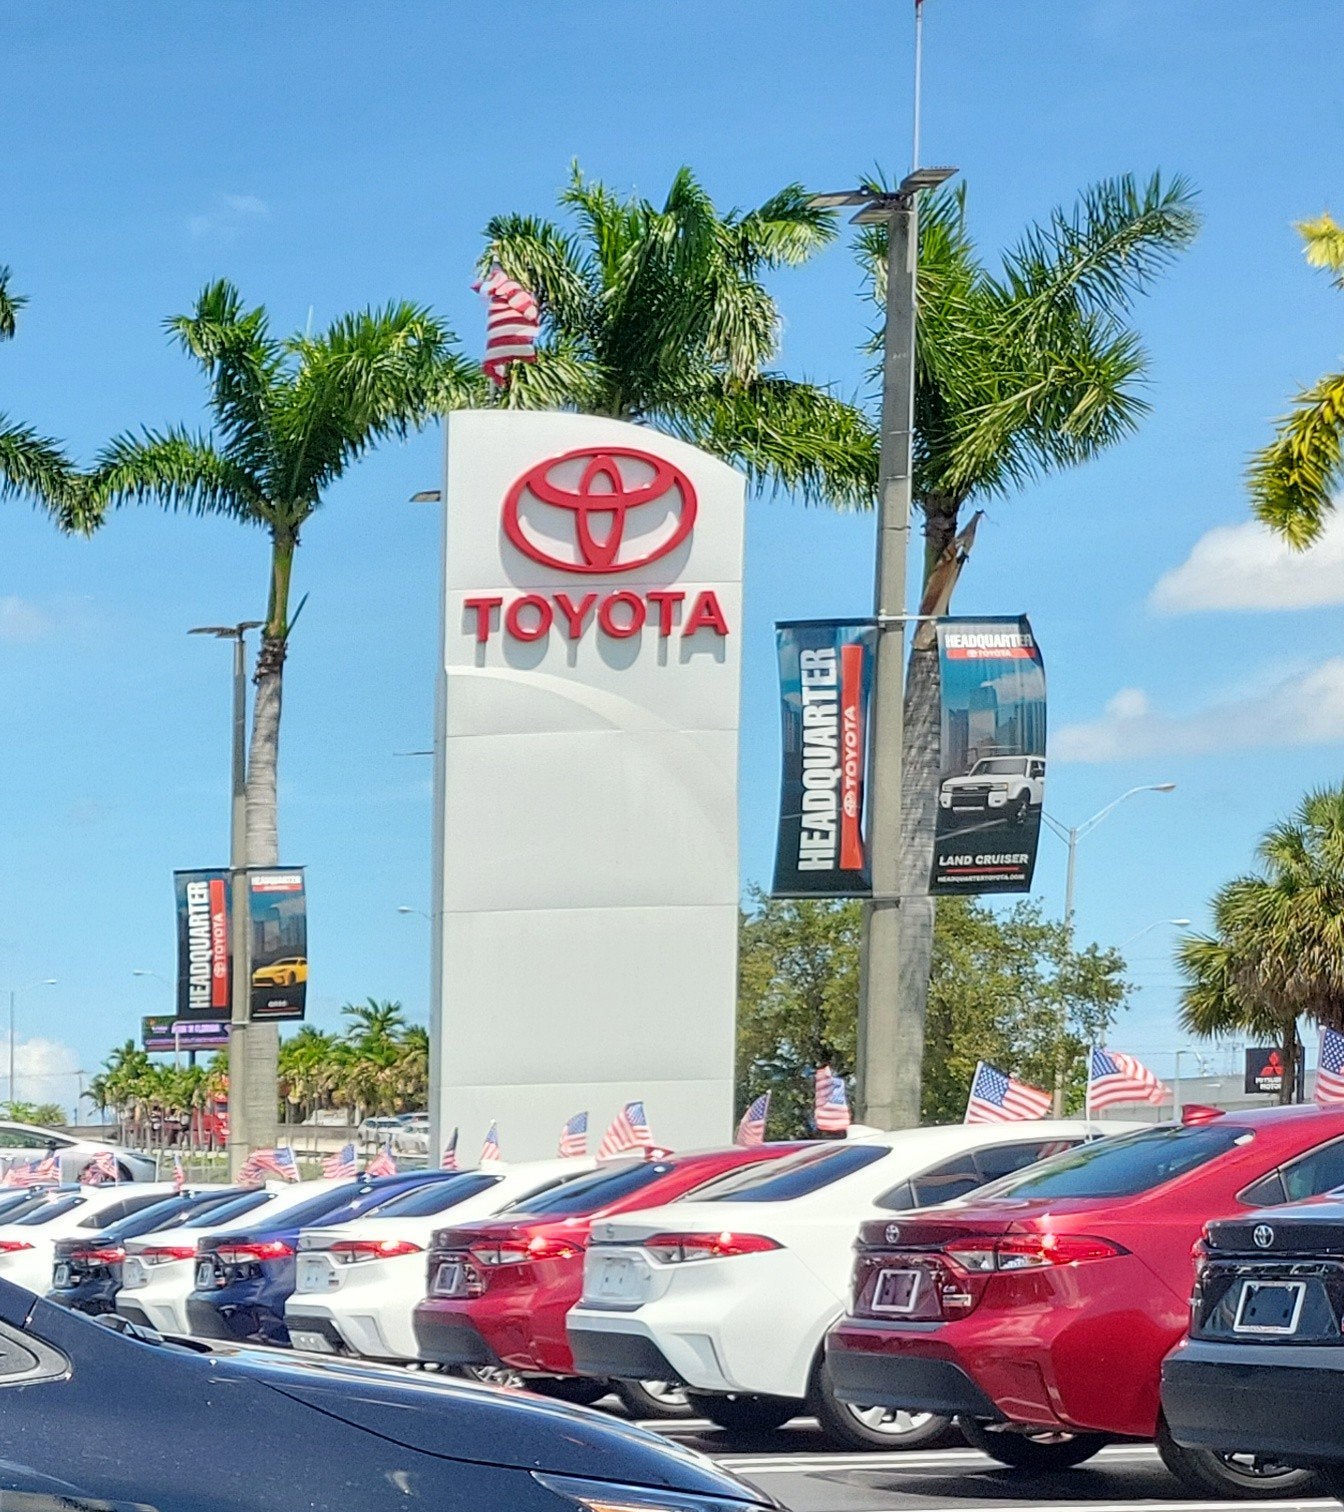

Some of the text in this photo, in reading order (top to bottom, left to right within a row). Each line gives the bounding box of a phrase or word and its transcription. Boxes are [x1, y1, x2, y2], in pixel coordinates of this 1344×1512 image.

[464, 590, 729, 642] TOYOTA
[945, 633, 1034, 650] HEADQUARTER
[798, 648, 842, 871] HEADQUARTER
[844, 705, 858, 790] TOYOTA
[939, 853, 1029, 866] LAND CRUISER
[187, 881, 213, 1009] HEADQUARTER
[213, 912, 227, 963] TOYOTA
